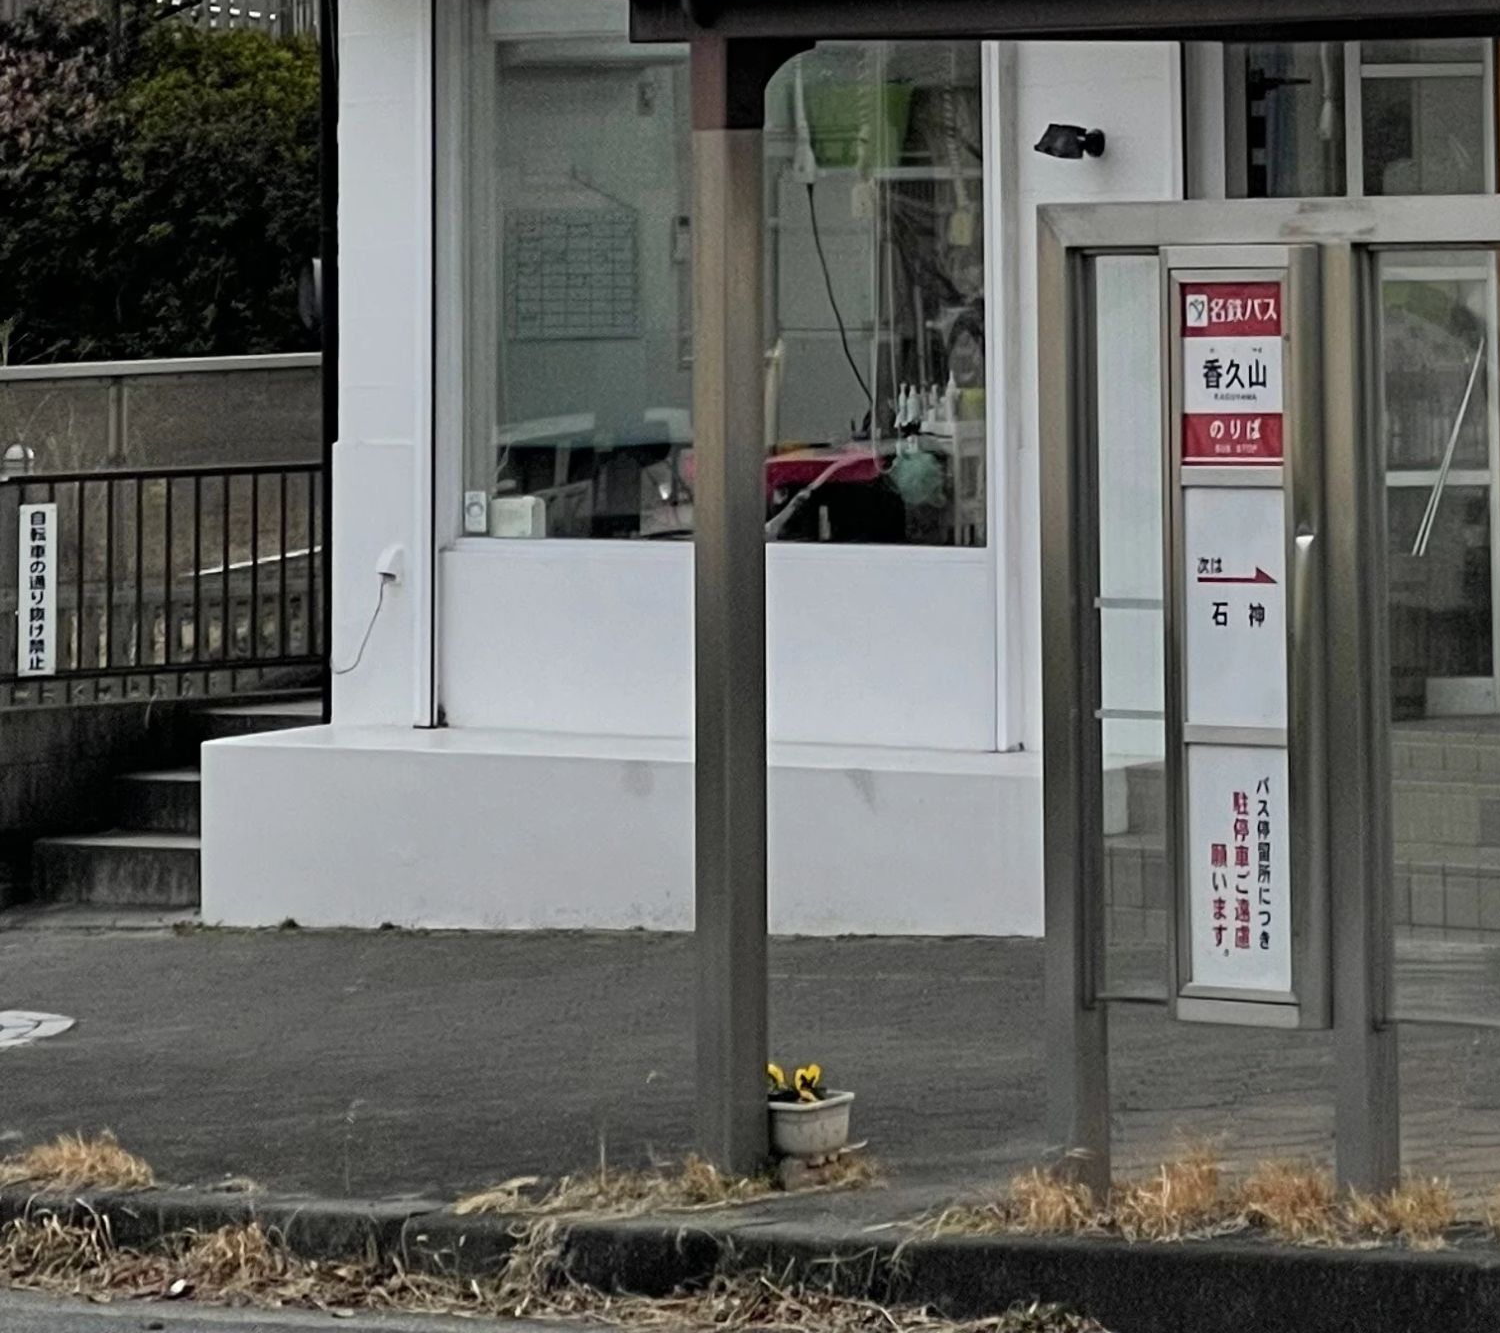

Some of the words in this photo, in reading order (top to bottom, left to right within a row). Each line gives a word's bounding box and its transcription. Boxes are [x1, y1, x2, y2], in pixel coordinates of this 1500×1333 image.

[1210, 298, 1277, 323] 名鉄バス
[1203, 358, 1267, 389] 香久山
[1210, 418, 1261, 440] のりば
[1197, 557, 1223, 574] 次は
[29, 511, 46, 671] 自転車の通り抜け禁止
[1233, 791, 1251, 949] 駐停車ご遠慮
[1256, 776, 1272, 950] バス停留所につき
